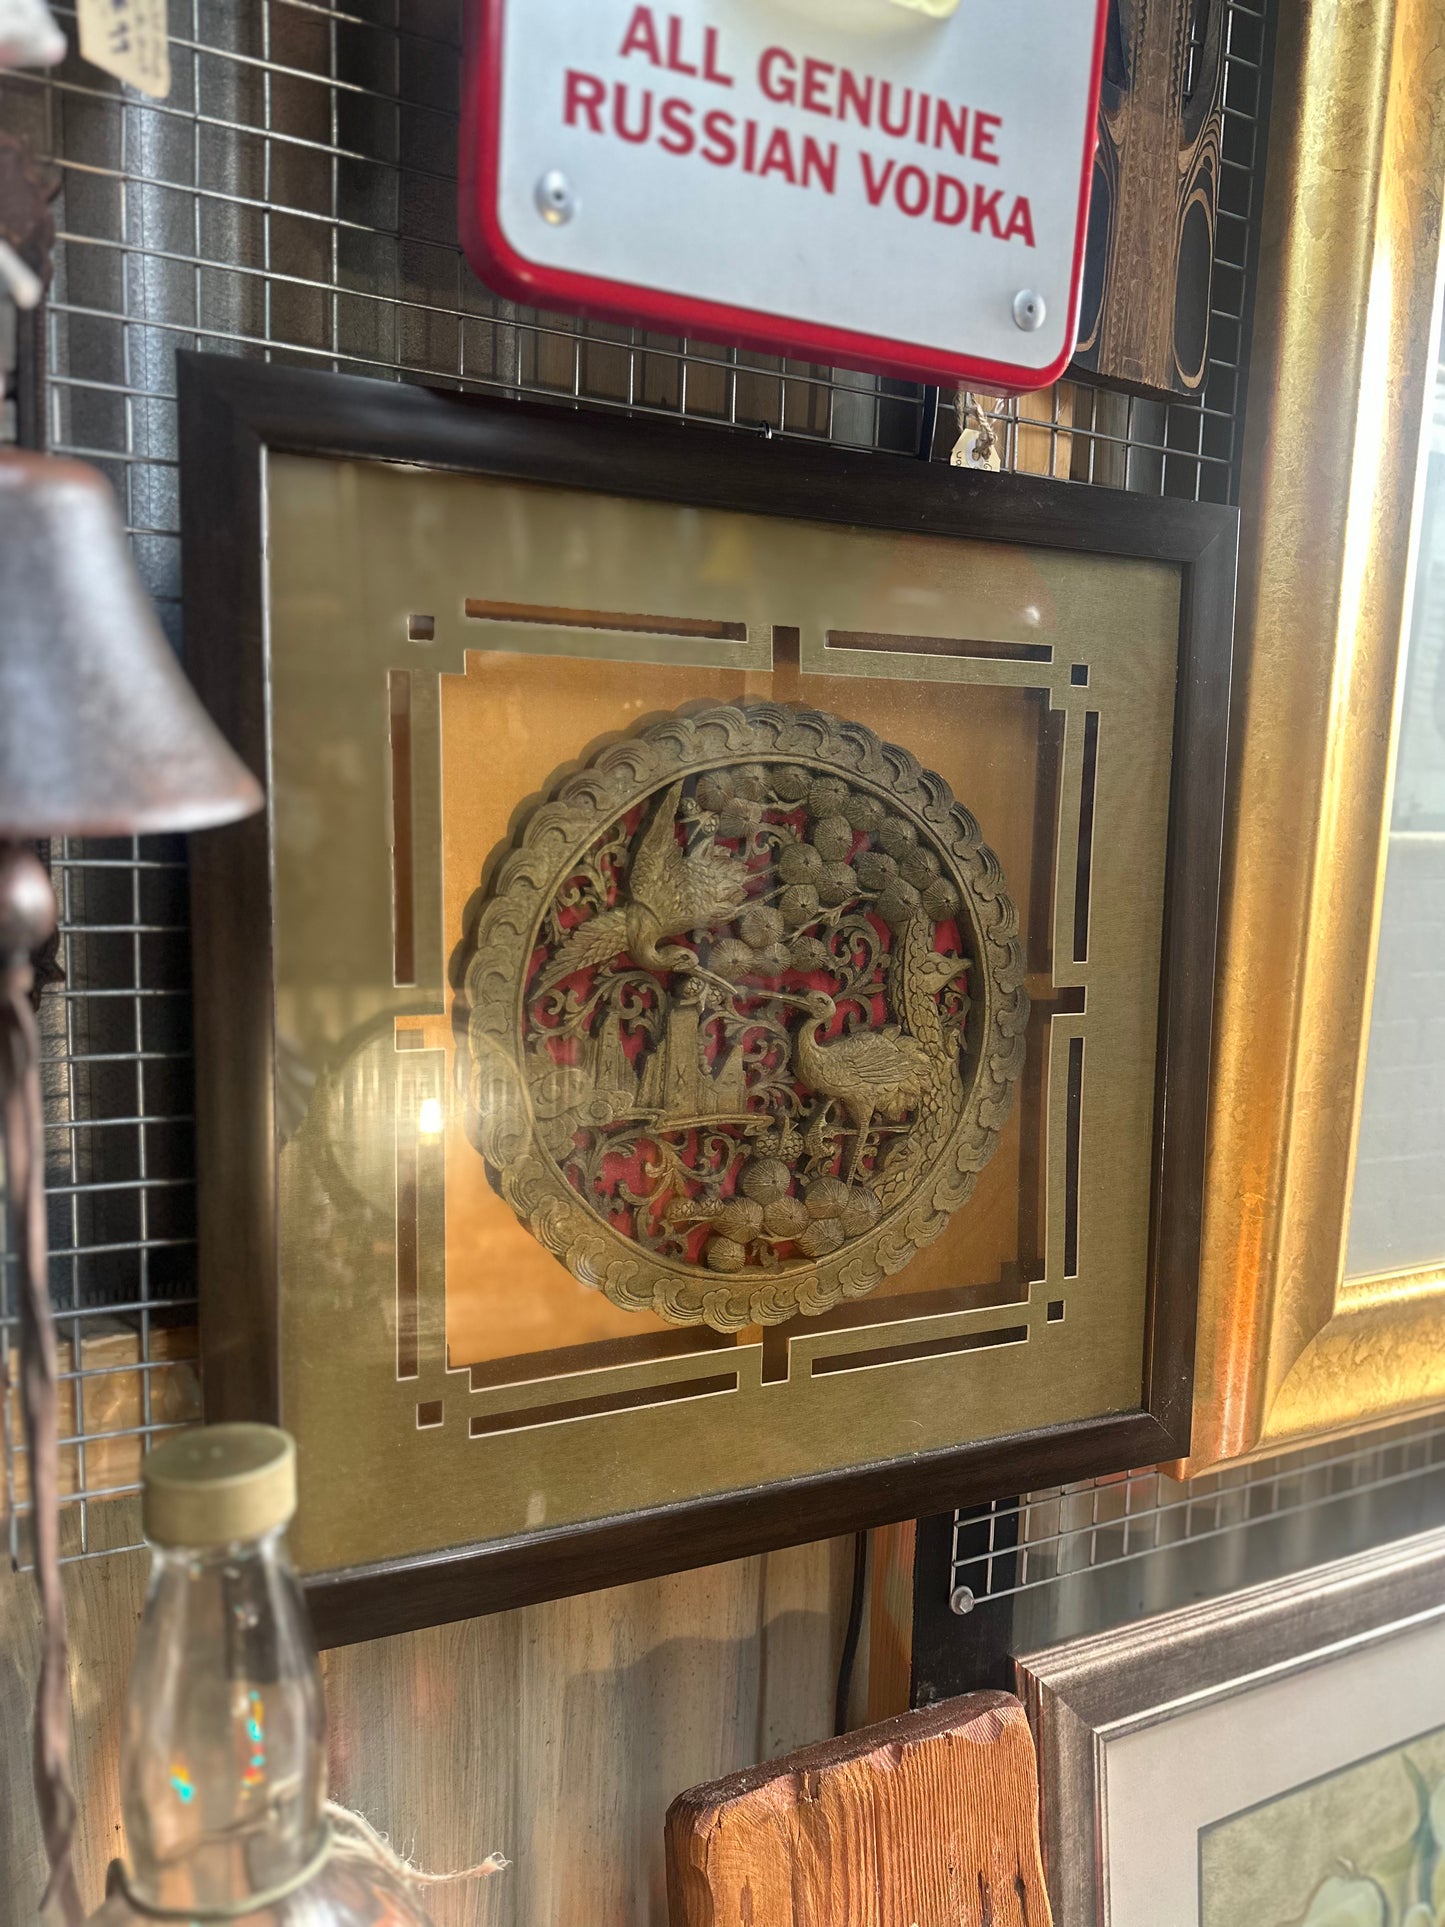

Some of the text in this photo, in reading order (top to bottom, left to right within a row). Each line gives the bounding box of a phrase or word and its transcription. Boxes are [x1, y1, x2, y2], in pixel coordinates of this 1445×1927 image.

[563, 69, 1036, 248] RUSSIAN VODKA
[619, 5, 1003, 166] ALL GENUINE
